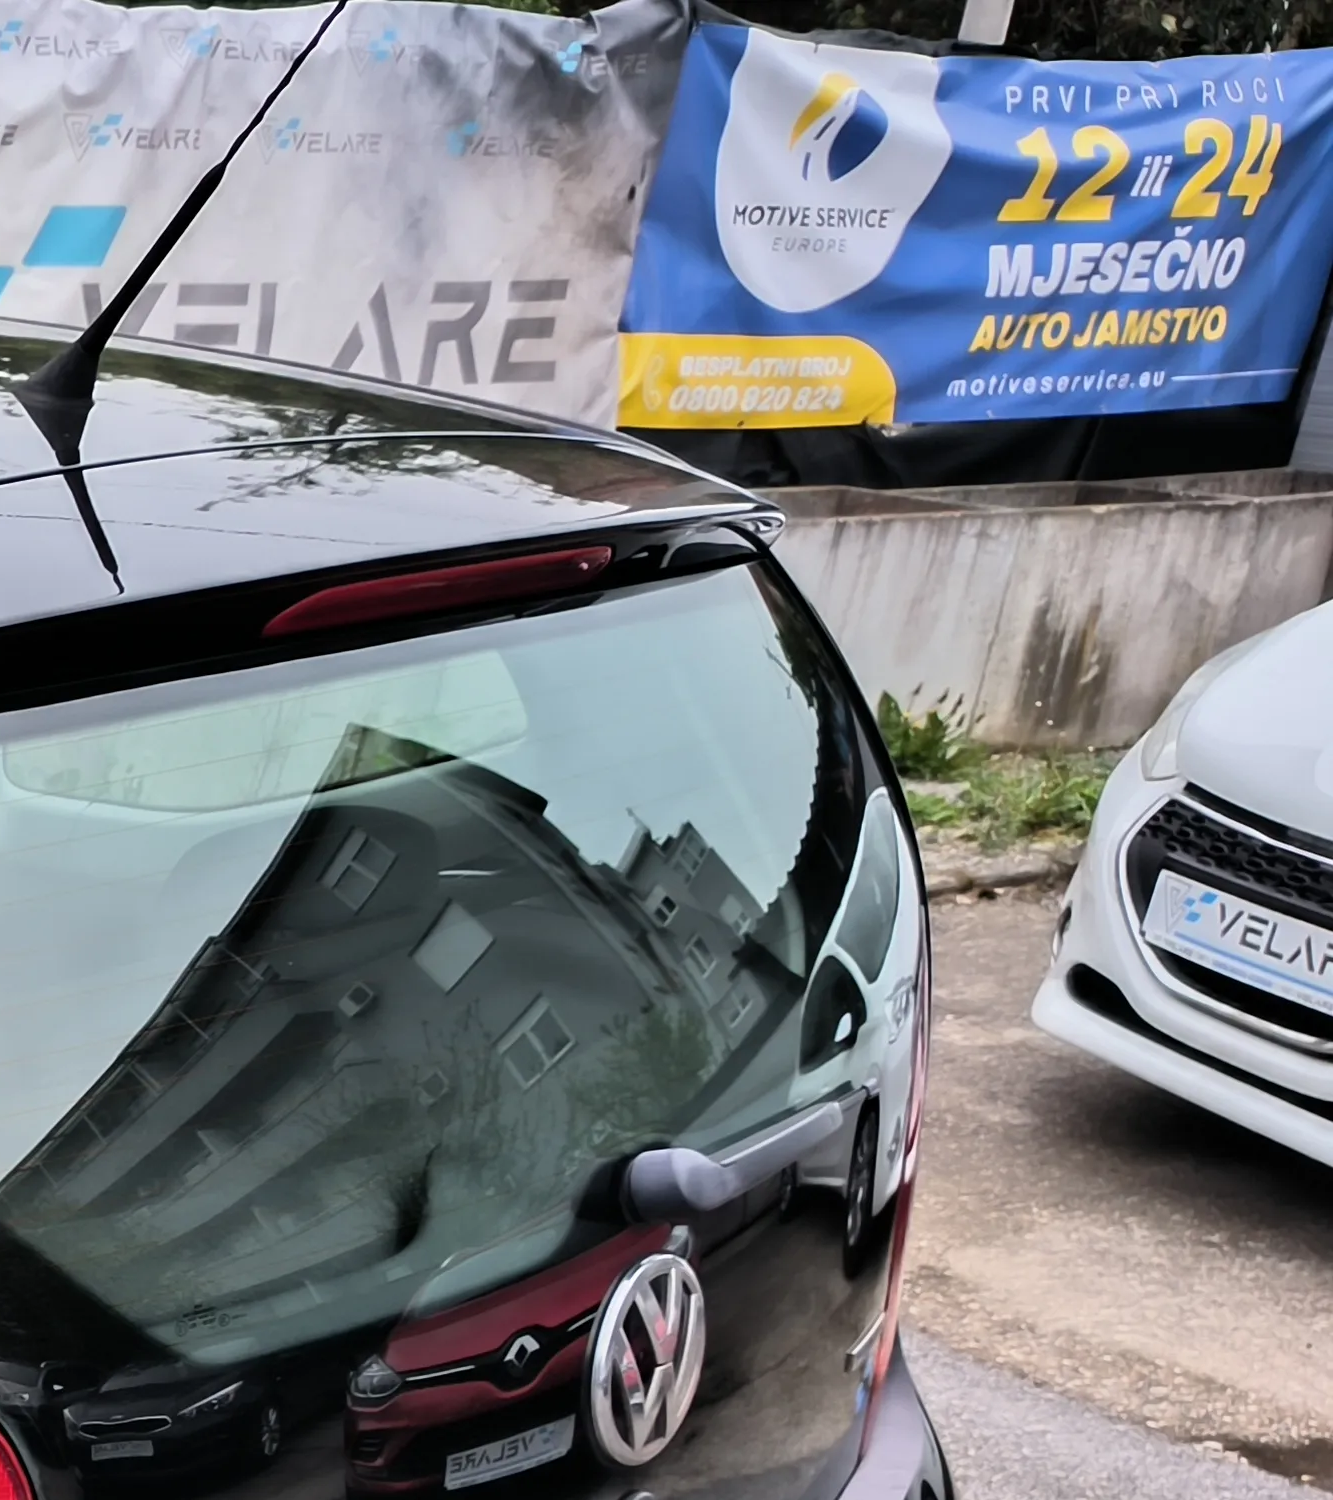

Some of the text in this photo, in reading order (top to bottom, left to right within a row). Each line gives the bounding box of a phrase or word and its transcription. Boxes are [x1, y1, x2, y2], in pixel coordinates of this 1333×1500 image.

[14, 35, 120, 59] VELARE
[1005, 77, 1284, 113] PRVI PRI RUCI
[292, 131, 382, 153] VELARE
[997, 114, 1282, 222] 12 ili 24
[733, 205, 889, 228] MOTIVE SERVICE
[772, 237, 847, 252] EUROPE
[985, 225, 1246, 298] MJESEČNO
[968, 305, 1228, 353] AUTO JAMSTVO
[679, 356, 851, 378] BESPLATNI BROJ
[946, 369, 1165, 397] motiveservice.eu
[668, 384, 739, 412] 0800
[740, 385, 792, 412] 820
